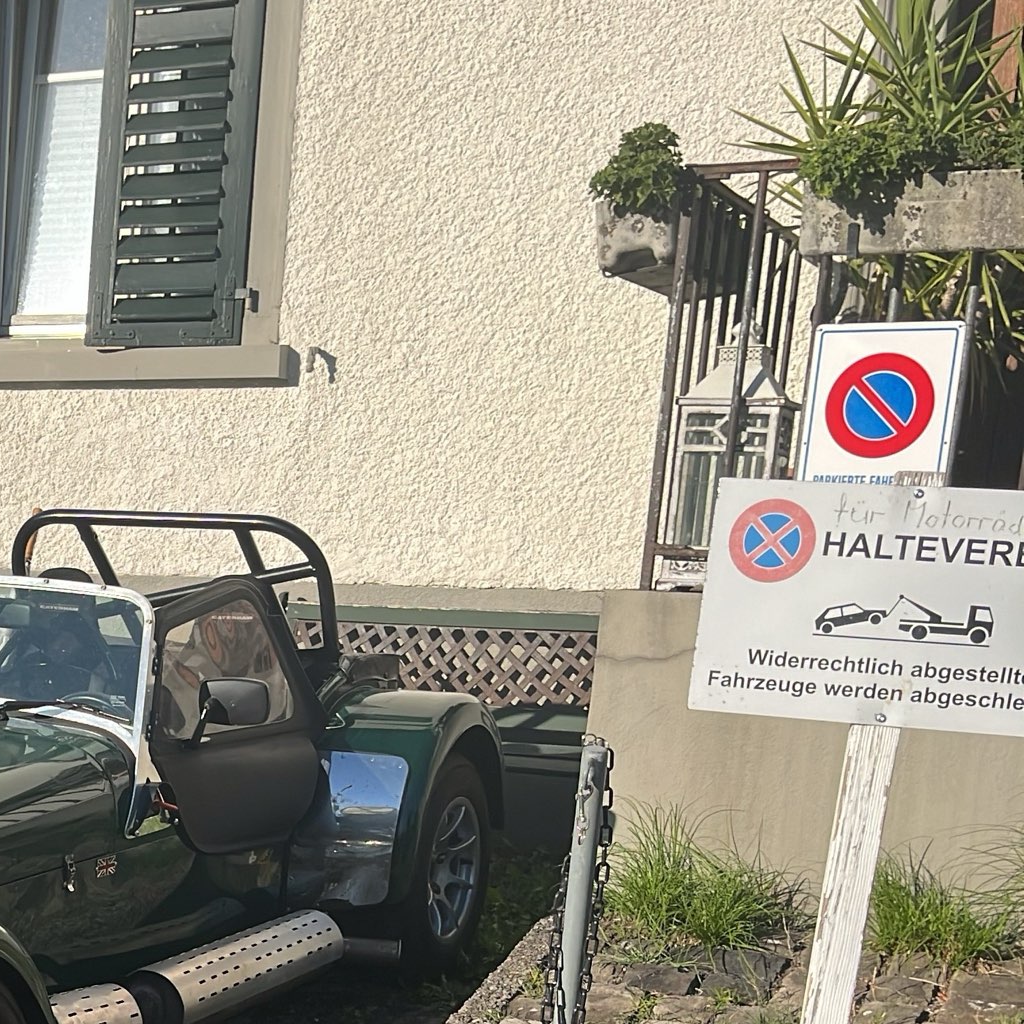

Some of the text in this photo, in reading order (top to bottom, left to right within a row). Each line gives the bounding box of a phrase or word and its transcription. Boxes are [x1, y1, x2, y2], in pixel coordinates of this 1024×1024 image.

[748, 648, 1024, 685] Widerrechtlich abgestellt
[707, 670, 1024, 711] Fahrzeuge werden abgeschle
